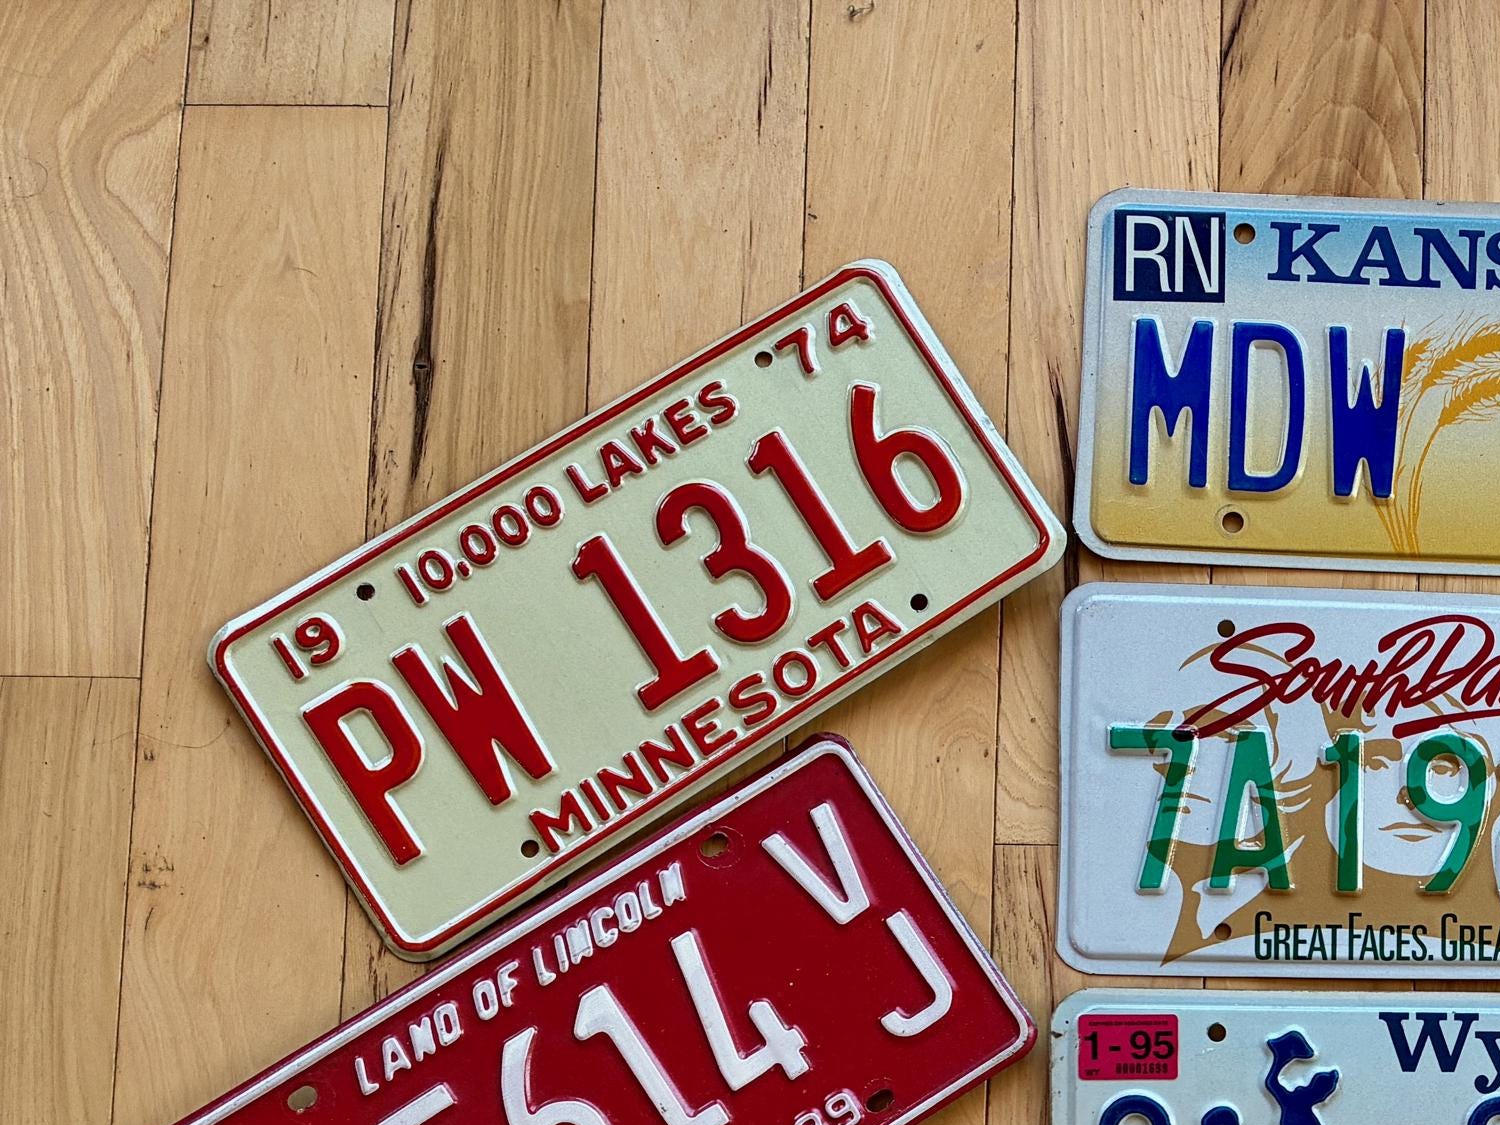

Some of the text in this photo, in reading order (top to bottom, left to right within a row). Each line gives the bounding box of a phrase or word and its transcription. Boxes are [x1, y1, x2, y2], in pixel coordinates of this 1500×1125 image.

[1124, 215, 1220, 294] RN
[774, 303, 872, 376] 74
[1129, 317, 1405, 500] MDW
[396, 381, 736, 605] 10,000 LAKES
[271, 616, 341, 679] 19
[302, 384, 965, 866] PW 1316
[1184, 621, 1436, 736] South
[528, 601, 901, 854] MINNESOTA
[353, 862, 689, 1096] LAND OF LINCOLN
[1255, 911, 1342, 961] GREAT
